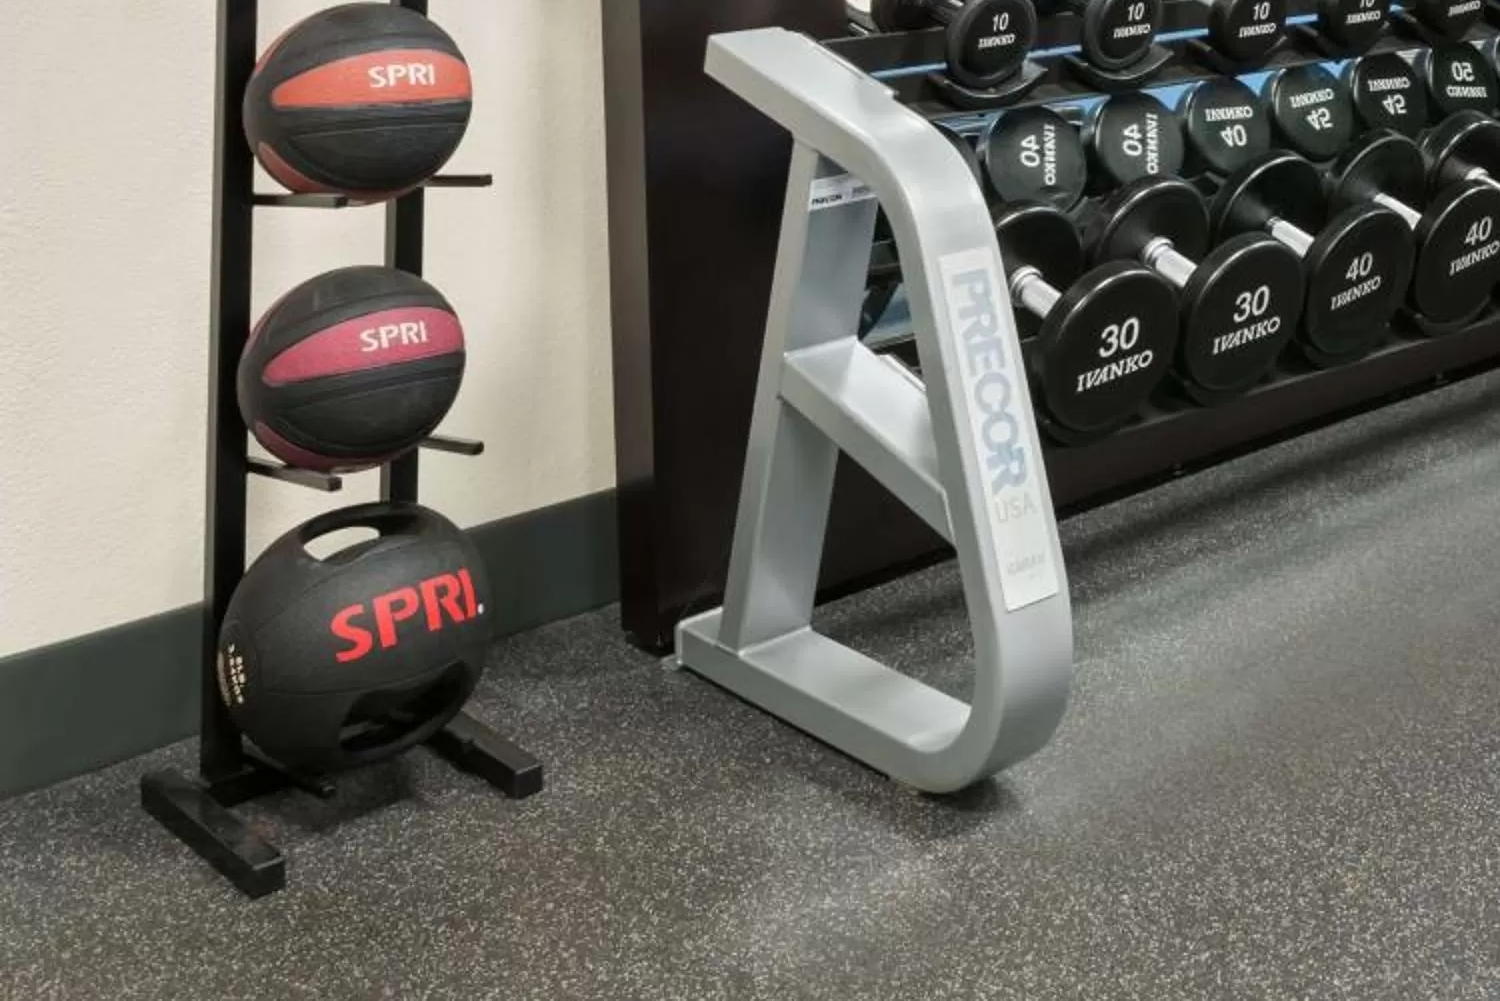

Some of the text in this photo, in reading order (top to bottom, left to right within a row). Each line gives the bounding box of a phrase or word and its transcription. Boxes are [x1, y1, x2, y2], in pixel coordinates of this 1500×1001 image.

[992, 12, 1009, 32] 10
[1127, 2, 1145, 22] 10
[1253, 1, 1270, 21] 10
[367, 64, 435, 89] SPRI
[1464, 216, 1492, 246] 40
[1345, 251, 1373, 280] 40
[1449, 240, 1500, 276] IVANKO
[1233, 285, 1270, 323] 30
[1330, 276, 1382, 310] IVANKO
[360, 320, 427, 352] SPRI
[1099, 317, 1140, 357] 30
[1212, 316, 1281, 355] IVANKO
[951, 267, 1027, 493] PRECOR
[1076, 350, 1154, 393] IVANKO
